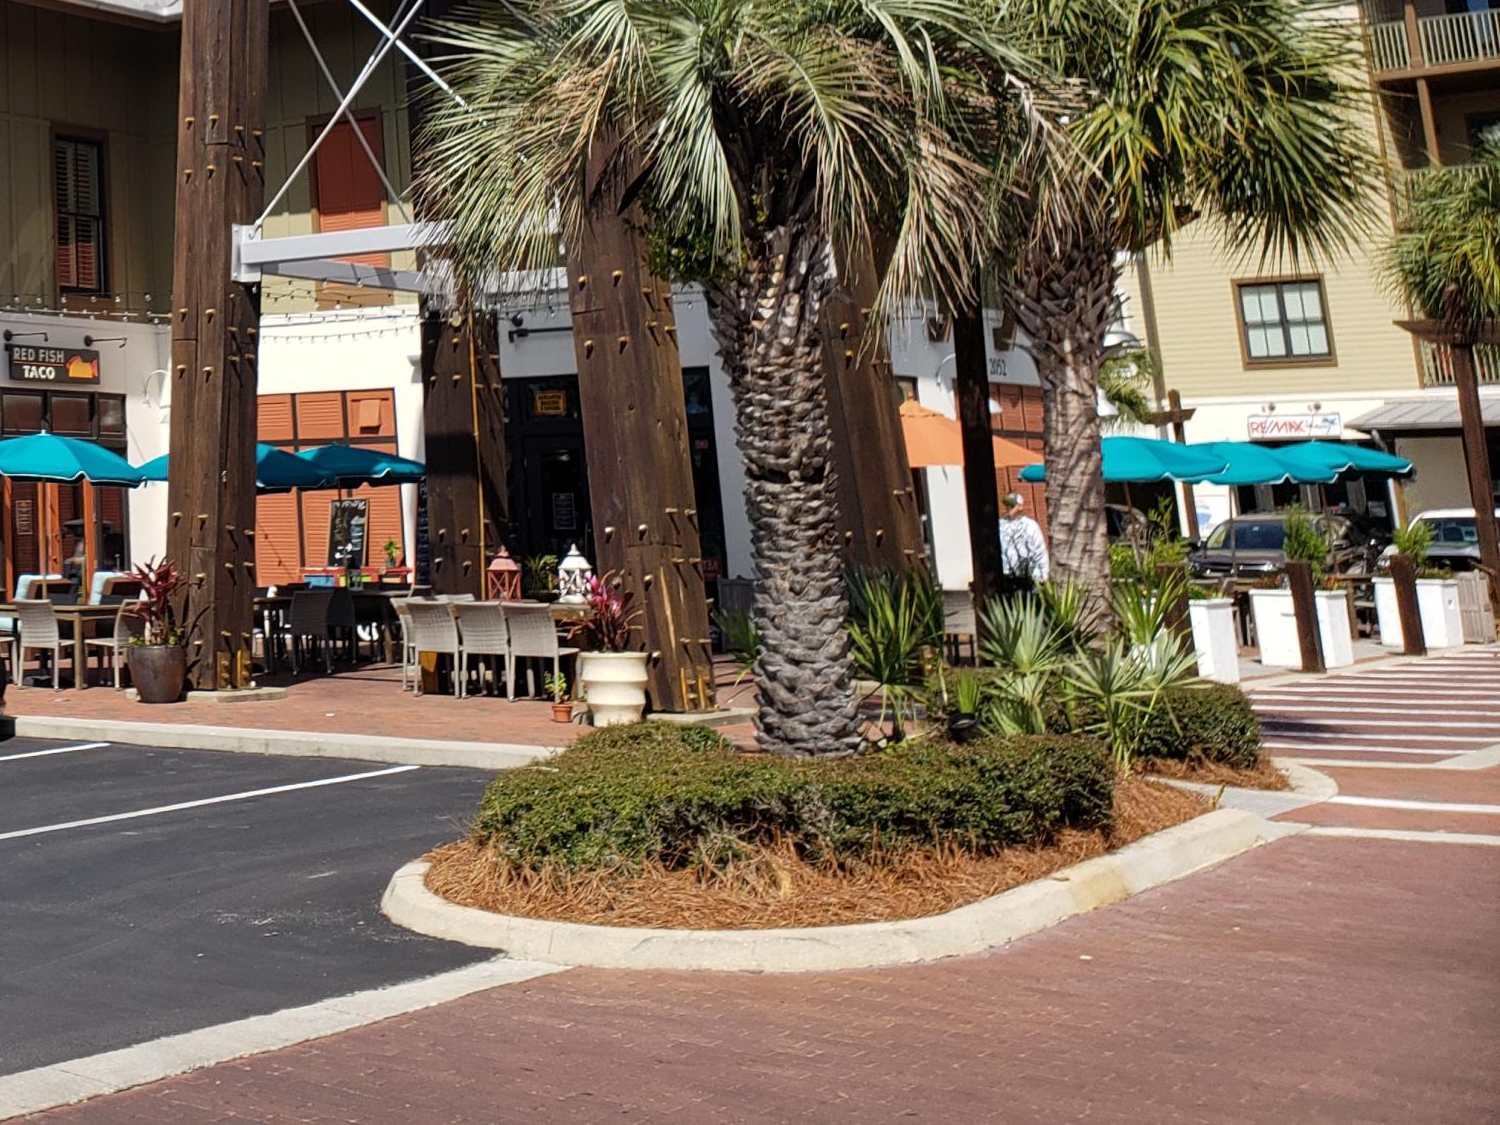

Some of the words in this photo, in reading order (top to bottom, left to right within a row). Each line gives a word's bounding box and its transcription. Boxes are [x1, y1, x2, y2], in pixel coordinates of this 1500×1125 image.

[13, 347, 35, 361] RED
[39, 349, 64, 363] FISH
[22, 365, 55, 379] TACO
[1250, 420, 1305, 434] RE/MAX
